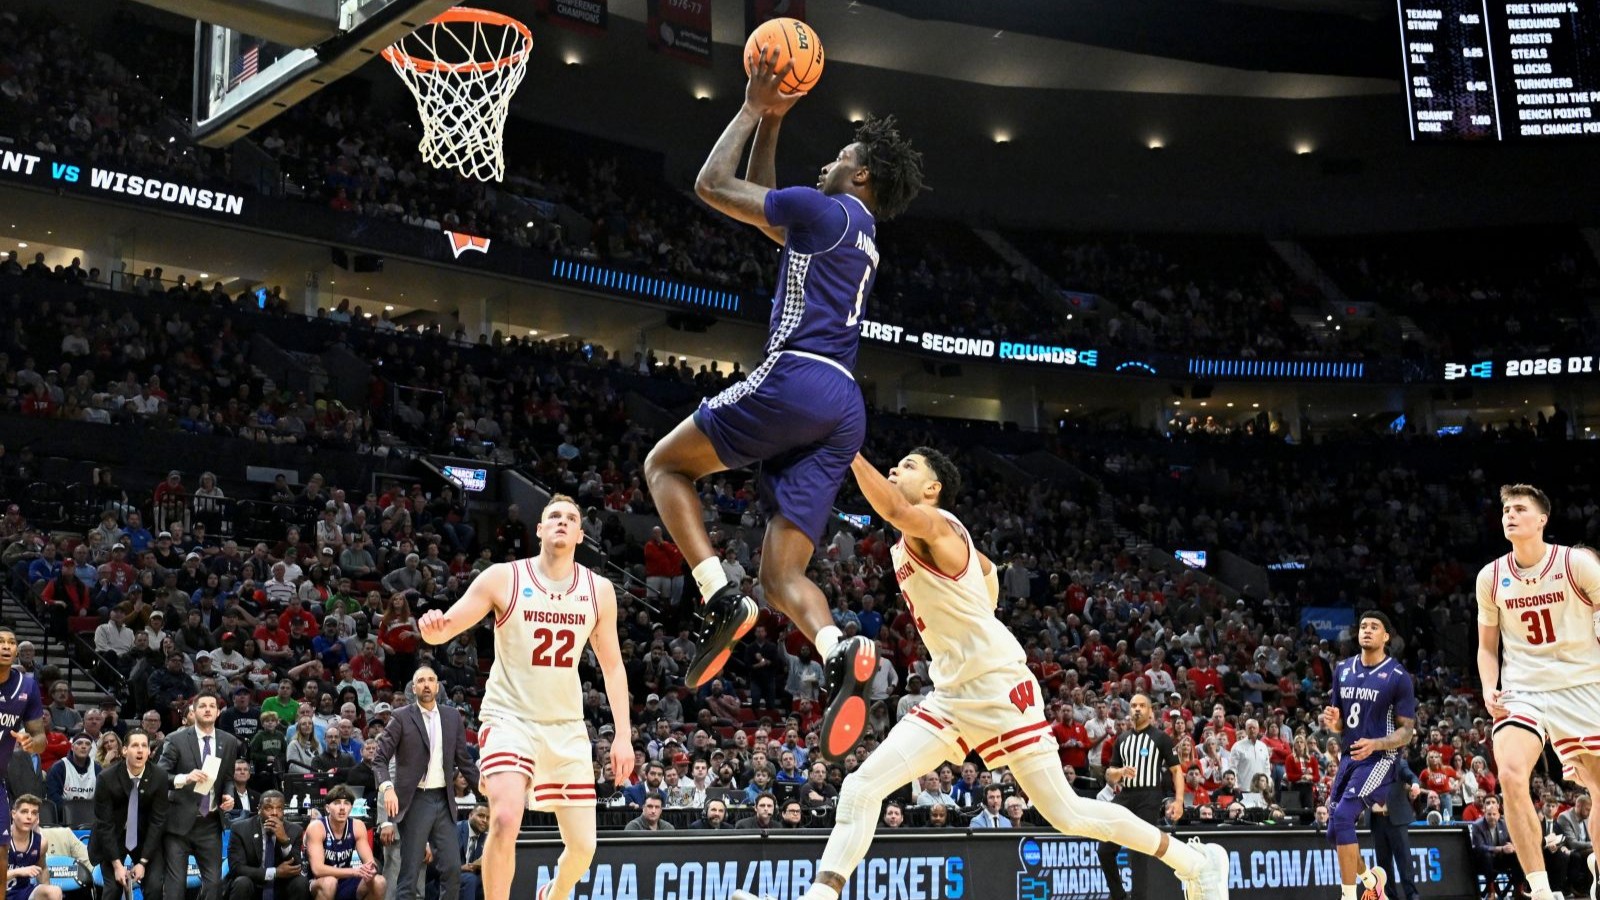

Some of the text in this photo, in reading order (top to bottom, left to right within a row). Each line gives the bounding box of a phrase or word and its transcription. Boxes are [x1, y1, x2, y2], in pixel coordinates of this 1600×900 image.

[557, 4, 600, 24] CHAMPIONS
[1506, 1, 1578, 14] FREE THROW %
[1508, 18, 1560, 29] REBOUNDS
[1510, 33, 1552, 44] ASSISTS
[1511, 48, 1548, 59] STEALS
[1513, 63, 1552, 74] BLOCKS
[1413, 76, 1430, 86] STL
[1515, 77, 1573, 89] TURNOVERS
[1517, 93, 1554, 105] POINTS
[1555, 93, 1569, 104] IN
[1569, 92, 1589, 103] THE
[1519, 107, 1592, 120] BENCH POINTS
[1521, 124, 1542, 136] 2ND
[1542, 123, 1582, 135] CHANCE
[51, 162, 80, 183] VS
[90, 167, 244, 215] WISCONSIN
[921, 332, 995, 357] SECOND
[1000, 342, 1077, 365] ROUNDS
[1506, 356, 1593, 377] 2026 DI
[1505, 591, 1565, 609] WISCONSIN
[523, 610, 586, 625] WISCONSIN
[1521, 608, 1556, 645] 31
[532, 628, 576, 667] 22
[1009, 680, 1035, 714] W
[1355, 687, 1379, 702] POINT
[1347, 702, 1360, 728] 8
